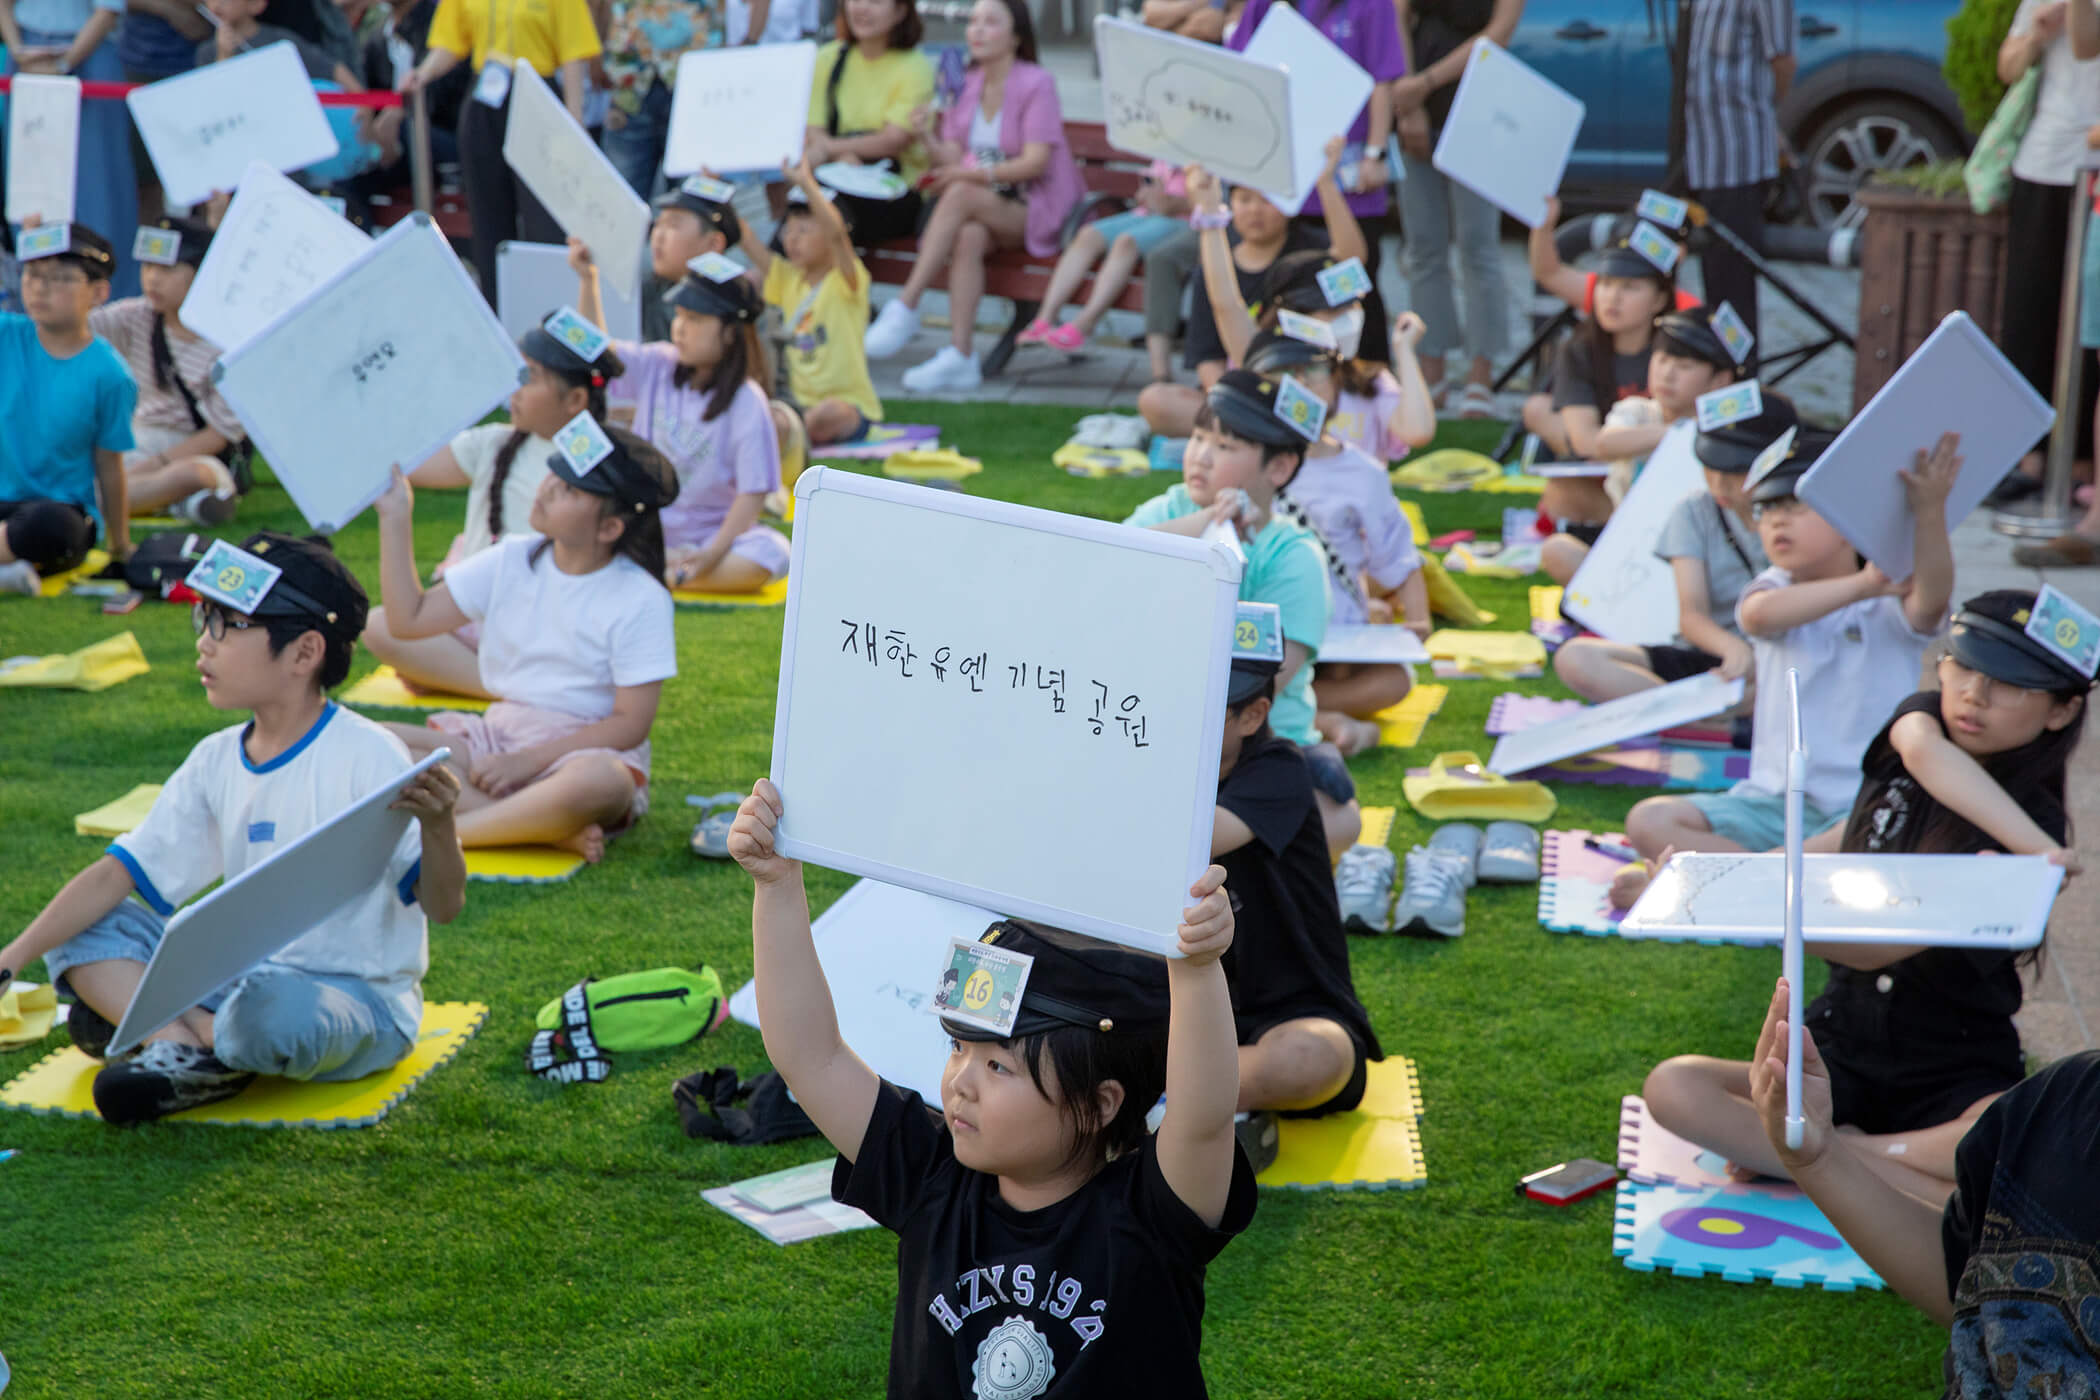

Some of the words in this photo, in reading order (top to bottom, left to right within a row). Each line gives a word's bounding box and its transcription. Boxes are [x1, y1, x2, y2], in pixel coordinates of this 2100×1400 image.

[220, 569, 242, 588] 23
[1238, 626, 1256, 643] 24
[1008, 662, 1066, 713] 기념
[1088, 679, 1149, 747] 공원
[966, 977, 990, 1003] 16
